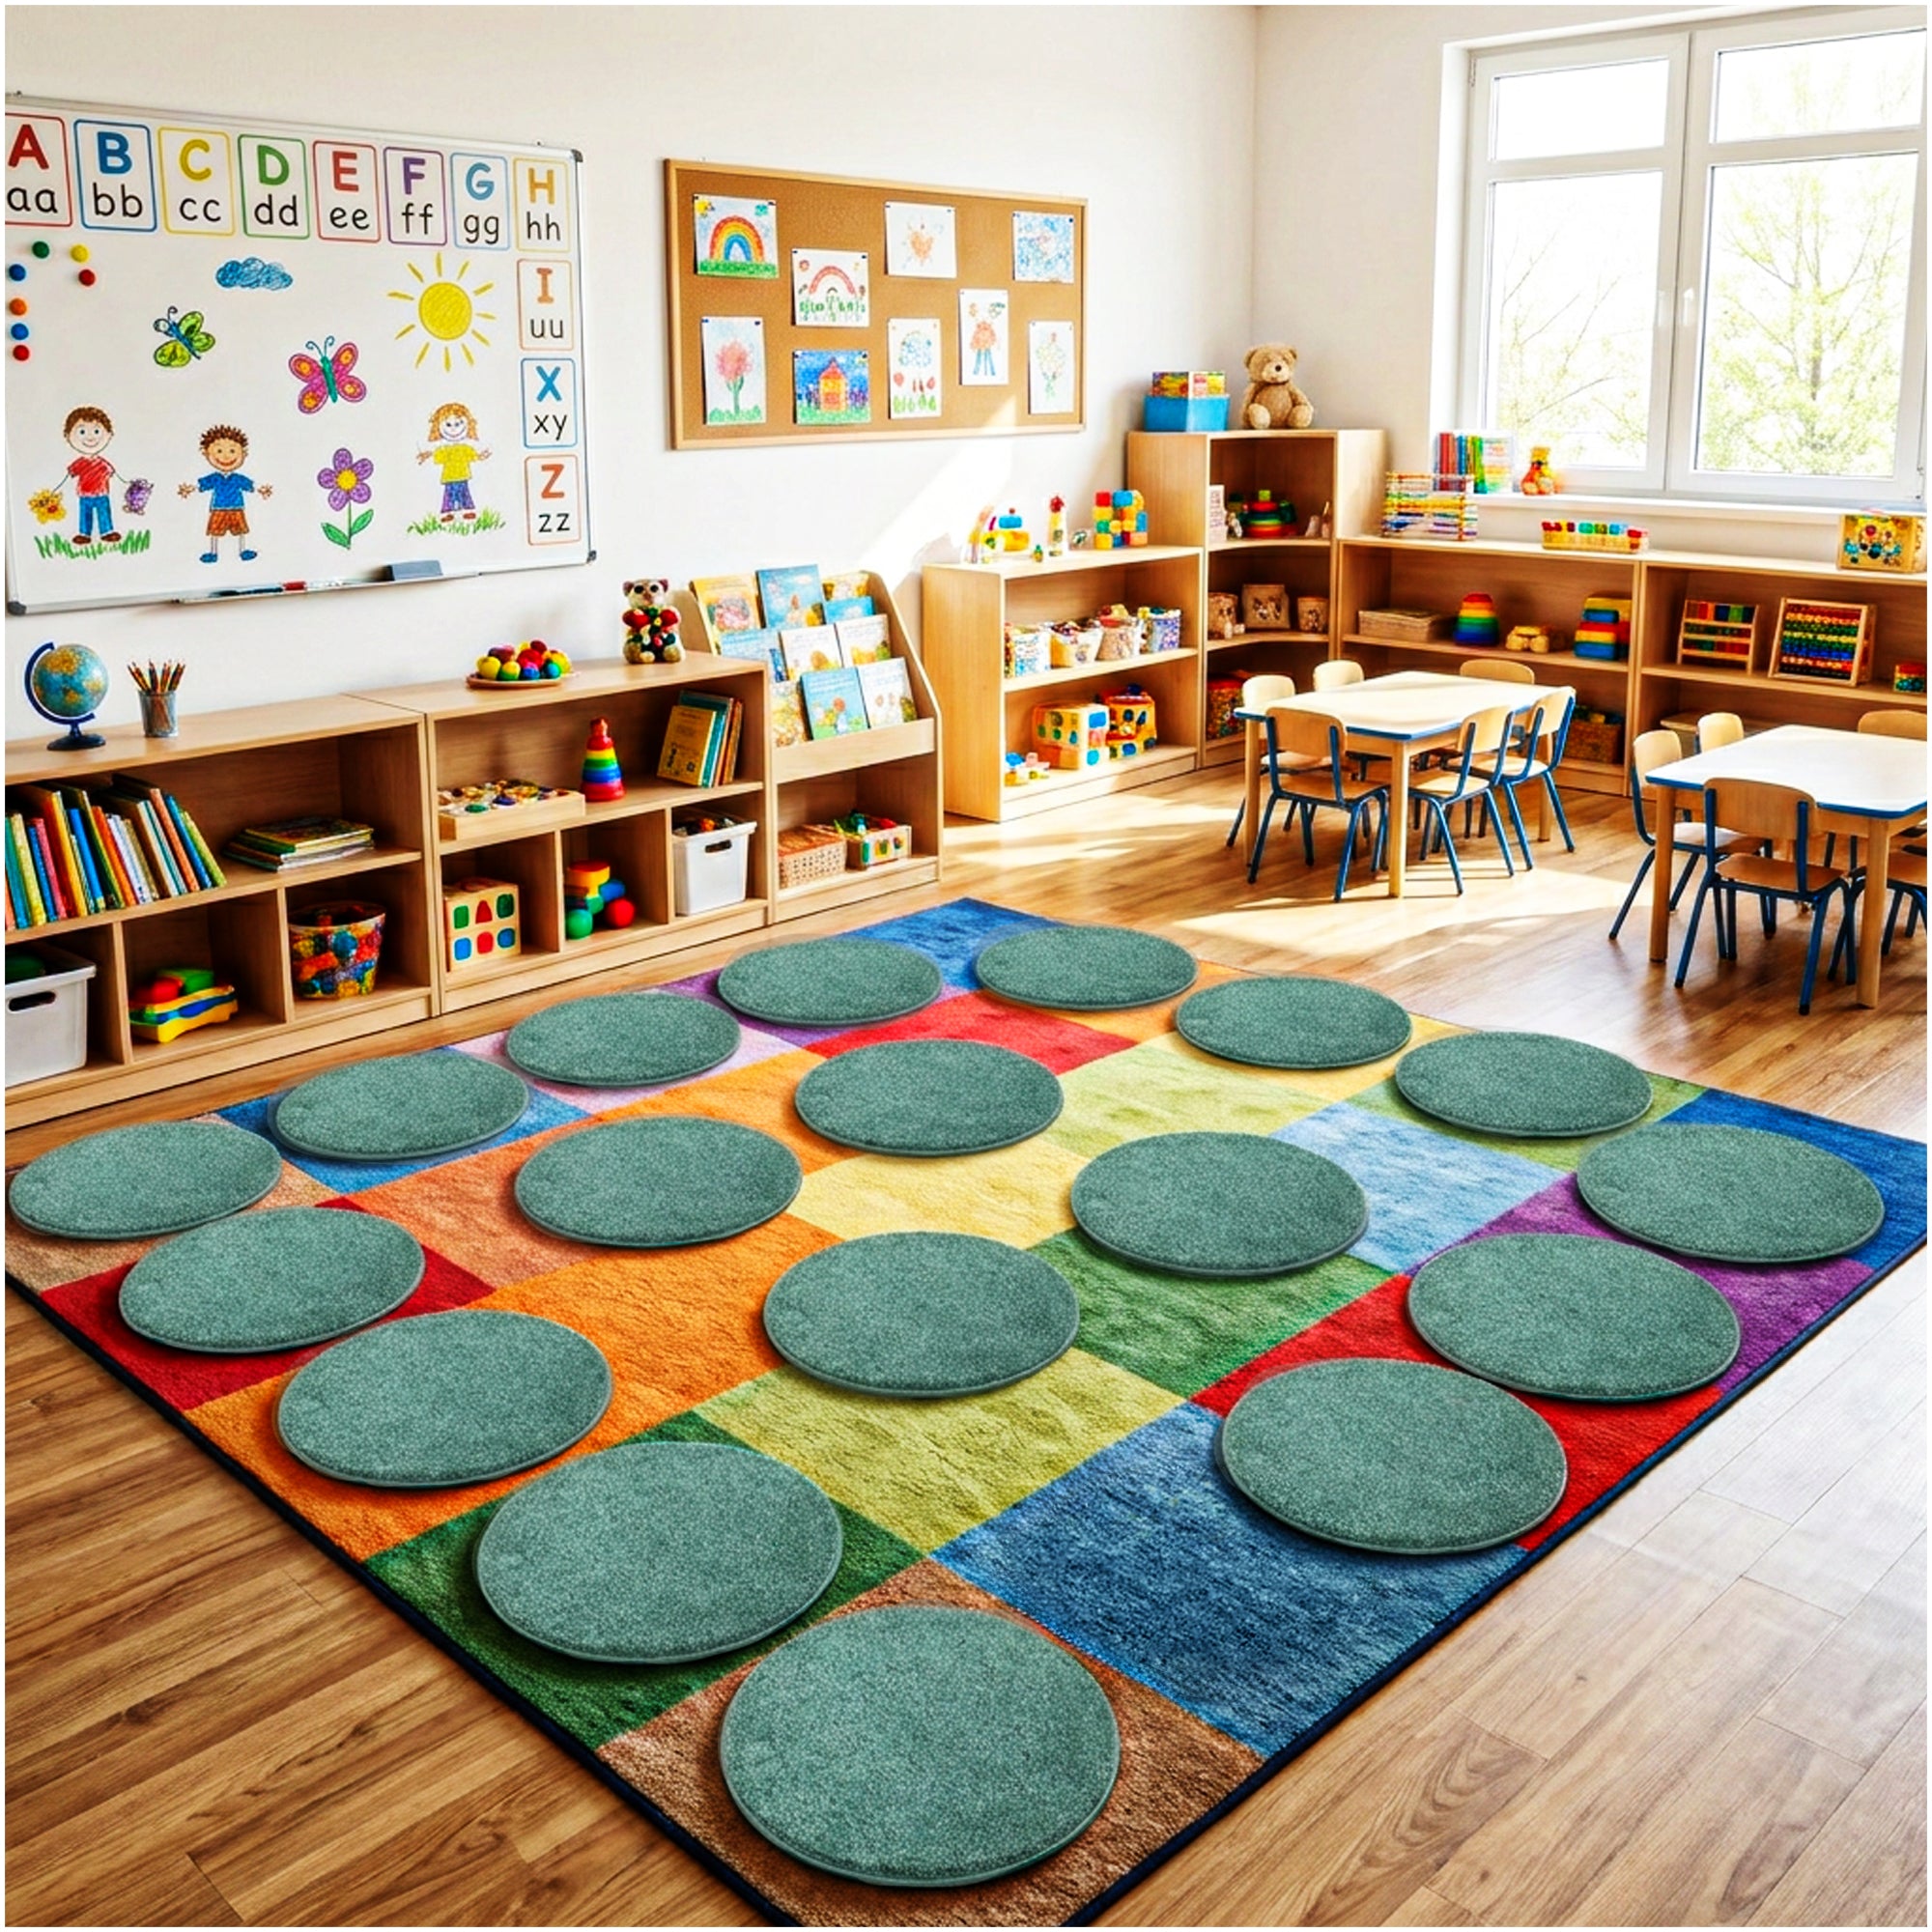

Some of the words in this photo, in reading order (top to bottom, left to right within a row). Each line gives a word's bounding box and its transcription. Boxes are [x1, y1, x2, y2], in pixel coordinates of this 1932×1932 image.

[8, 124, 49, 170] A
[97, 131, 132, 175] B
[179, 138, 213, 183] C
[257, 144, 290, 185] D
[332, 151, 359, 192] E
[403, 157, 425, 194] F
[466, 162, 494, 200] G
[6, 186, 59, 214] aa
[92, 182, 143, 218] bb
[528, 168, 554, 204] H
[179, 197, 221, 223] cc
[253, 193, 298, 227] dd
[329, 207, 370, 231] ee
[401, 202, 434, 236] ff
[526, 211, 560, 241] hh
[463, 214, 499, 245] gg
[537, 268, 553, 303] I
[530, 319, 563, 339] uu
[536, 366, 561, 402] X
[533, 414, 567, 441] xy
[542, 464, 564, 498] Z
[538, 513, 570, 533] zz
